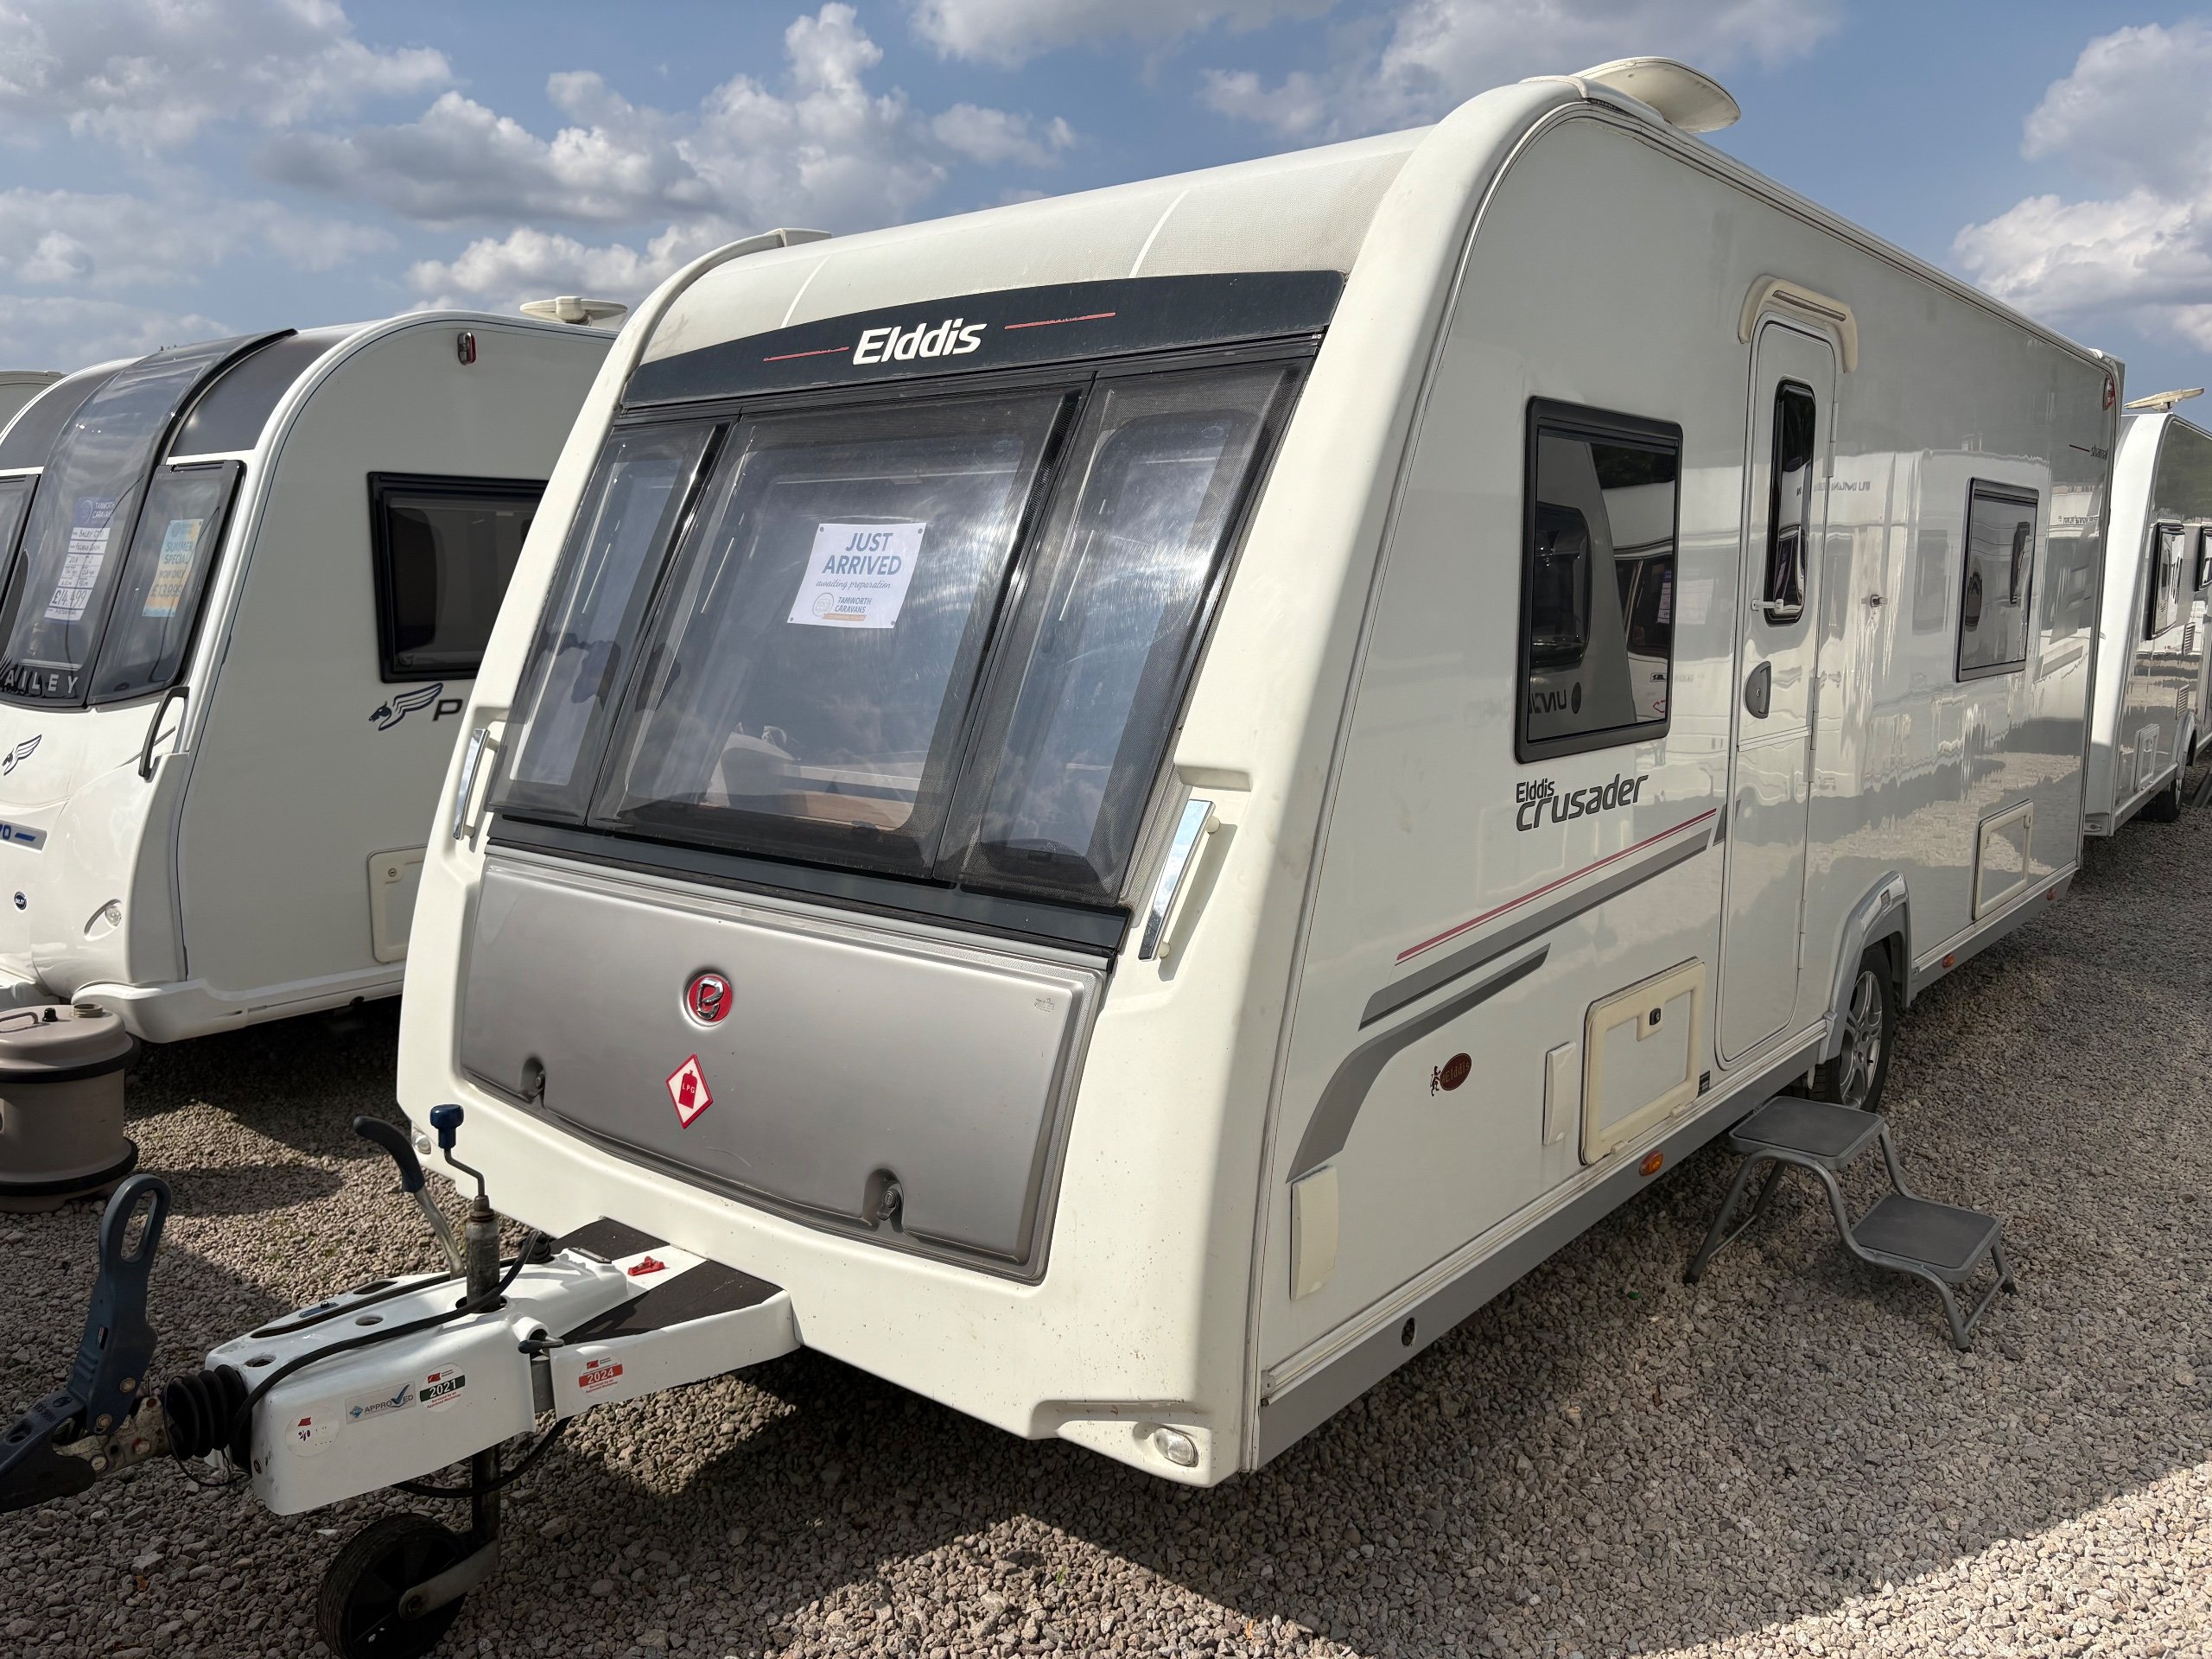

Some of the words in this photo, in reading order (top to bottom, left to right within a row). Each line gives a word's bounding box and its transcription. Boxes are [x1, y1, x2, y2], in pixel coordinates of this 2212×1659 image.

[853, 317, 988, 365] Elddis
[166, 541, 194, 552] SUMMER
[845, 532, 893, 552] JUST
[164, 554, 190, 564] SPECIAL
[822, 555, 902, 575] ARRIVED
[817, 578, 848, 591] awaiting
[849, 580, 891, 593] preparation
[835, 605, 867, 613] CARAVANS
[838, 596, 873, 606] TAMWORTH
[1516, 778, 1555, 803] Elddis
[682, 1082, 696, 1094] LPG
[588, 1367, 614, 1384] 2024
[429, 1378, 456, 1398] 2021
